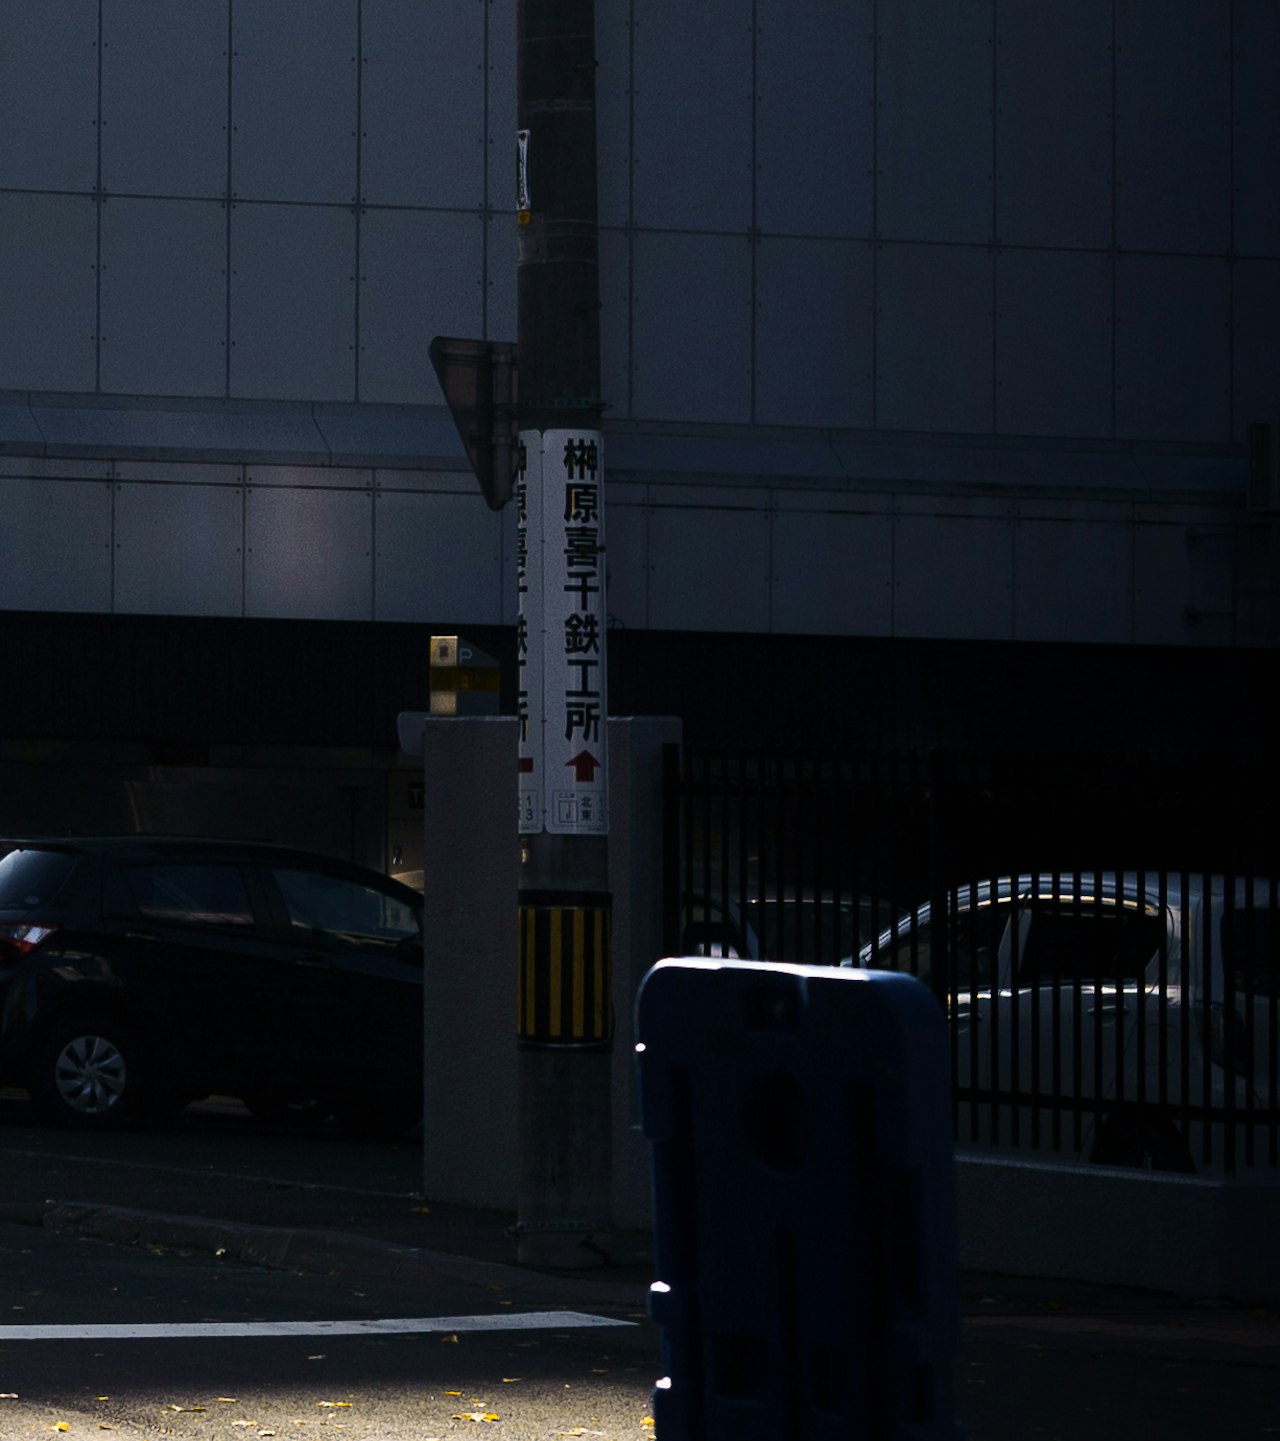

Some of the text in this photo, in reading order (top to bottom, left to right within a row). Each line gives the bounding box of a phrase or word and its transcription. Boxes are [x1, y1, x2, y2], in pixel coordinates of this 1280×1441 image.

[459, 648, 473, 664] P
[563, 438, 600, 743] 榊原喜千鉄工所
